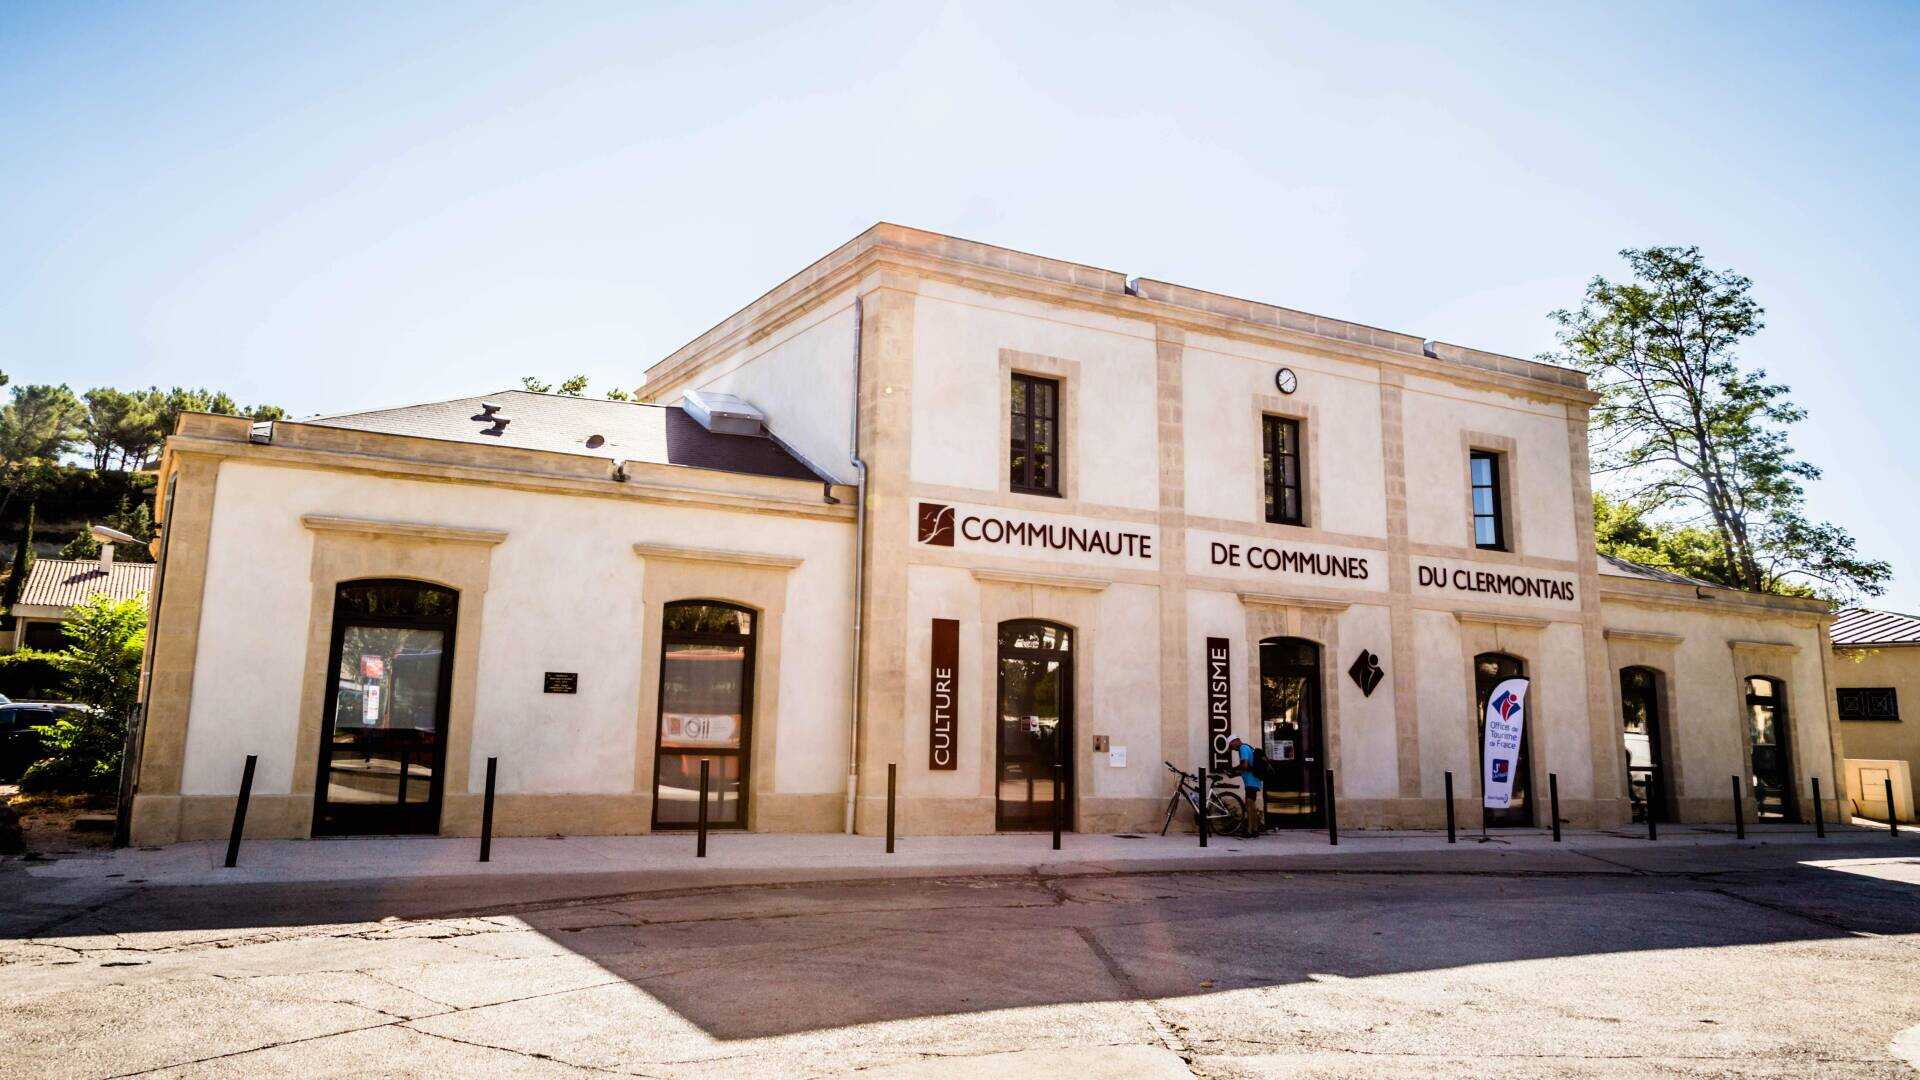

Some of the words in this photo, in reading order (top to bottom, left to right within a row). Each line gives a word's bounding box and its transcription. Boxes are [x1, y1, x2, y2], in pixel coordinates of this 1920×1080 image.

[961, 516, 1151, 558] COMMUNAUTE
[1211, 542, 1240, 567] DE
[1247, 546, 1368, 579] COMMUNES
[1418, 565, 1446, 587] DU
[1452, 570, 1574, 601] CLERMONTAIS
[934, 667, 951, 765] CULTURE
[1212, 648, 1229, 768] TOURISME
